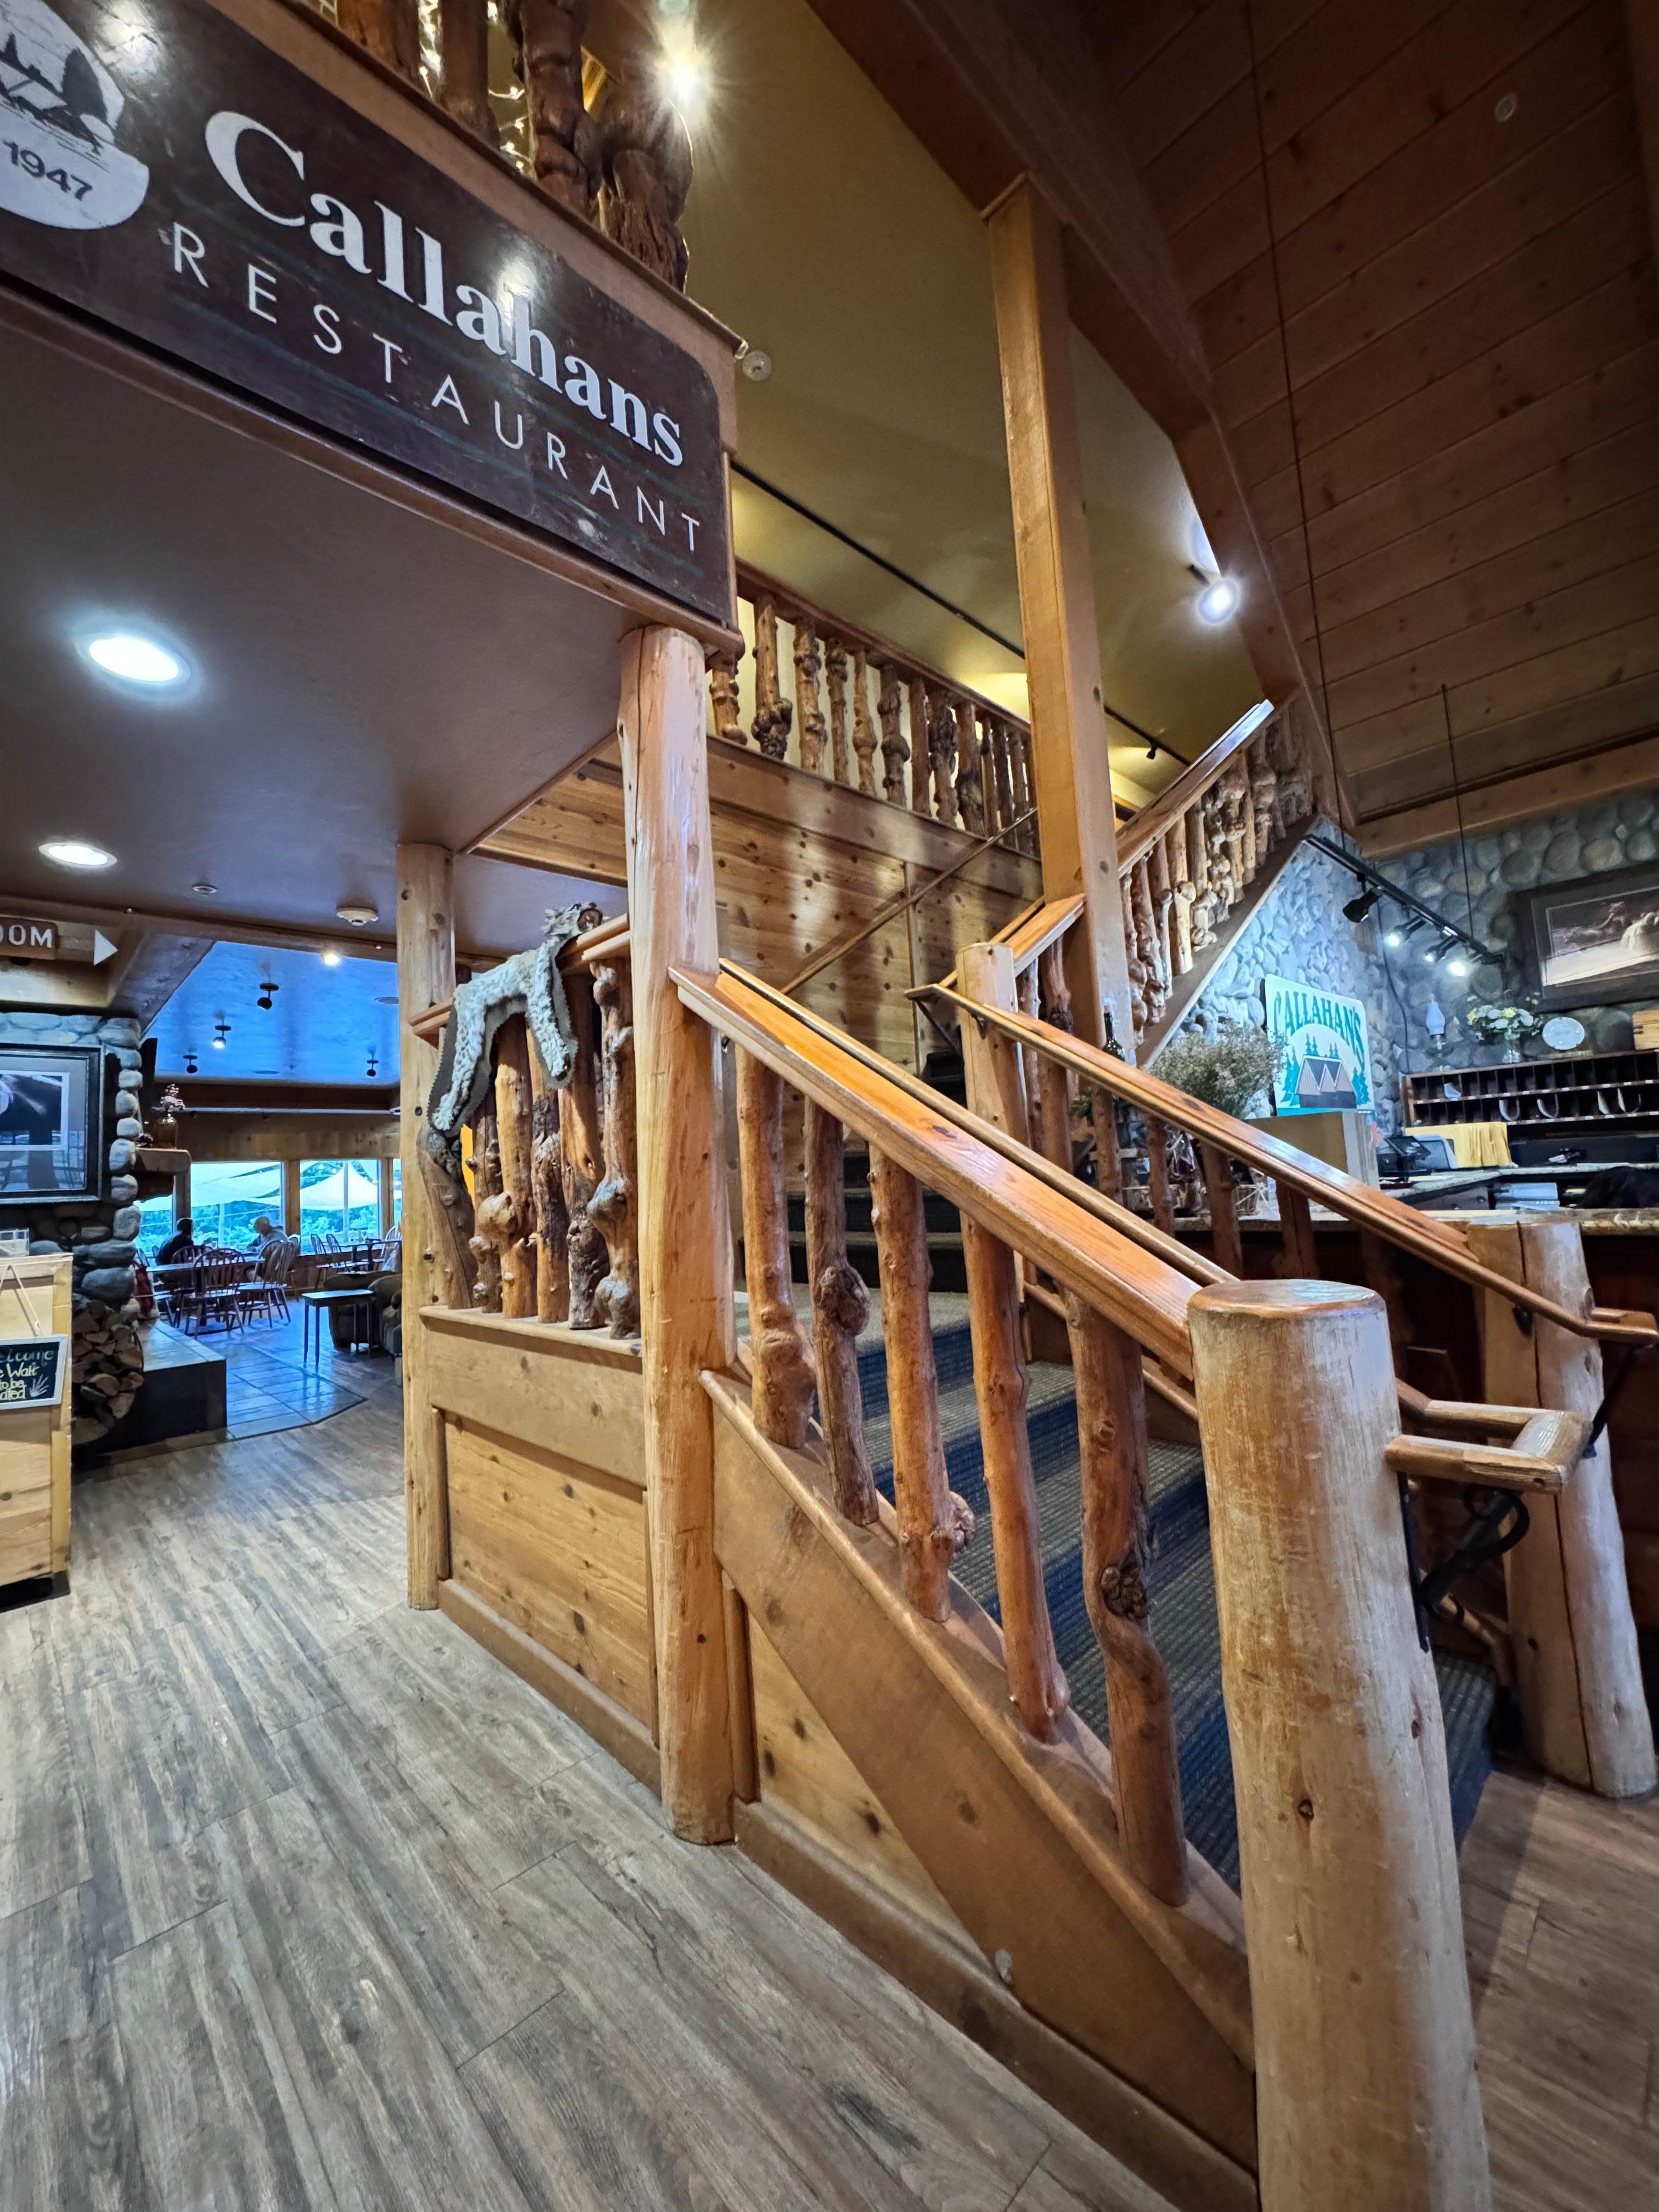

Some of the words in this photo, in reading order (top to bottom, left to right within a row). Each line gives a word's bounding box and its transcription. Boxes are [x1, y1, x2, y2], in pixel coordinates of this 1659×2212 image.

[3, 139, 93, 201] 1947
[205, 111, 684, 467] Callahans
[173, 222, 700, 552] RESTAURANT
[0, 924, 52, 948] OM
[1274, 990, 1365, 1071] CALLAHAN'S
